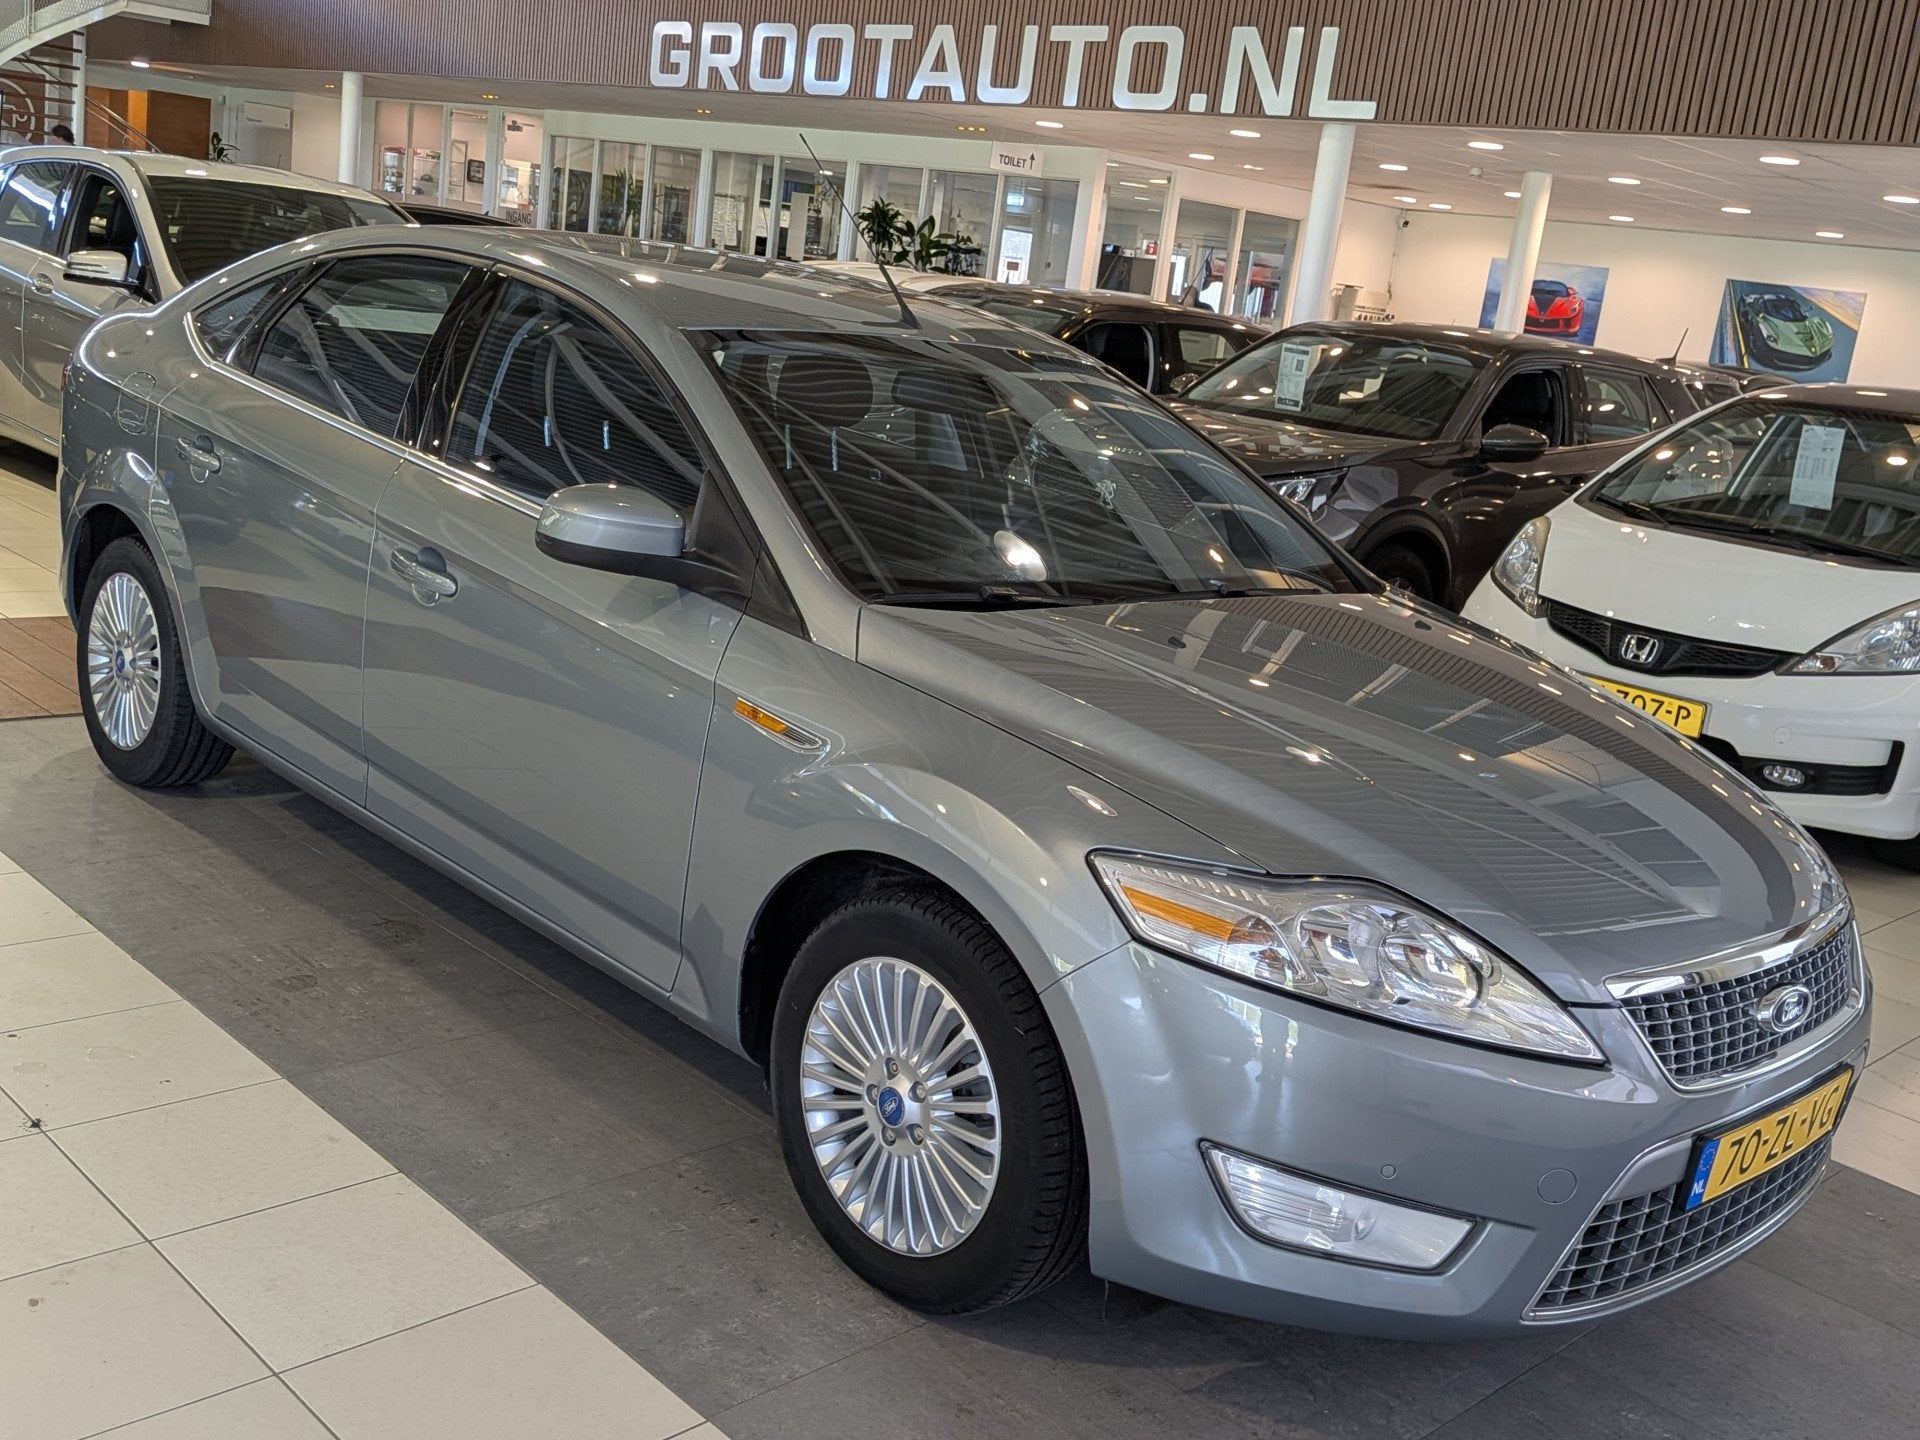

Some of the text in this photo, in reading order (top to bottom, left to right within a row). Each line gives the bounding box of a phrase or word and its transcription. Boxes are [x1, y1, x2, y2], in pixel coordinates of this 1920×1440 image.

[650, 20, 1377, 120] GROOTAUTO.NL
[998, 153, 1028, 169] TOILET
[505, 210, 532, 225] INGANG
[1719, 1084, 1840, 1187] 70-ZL-VG
[1690, 1178, 1705, 1197] NL
